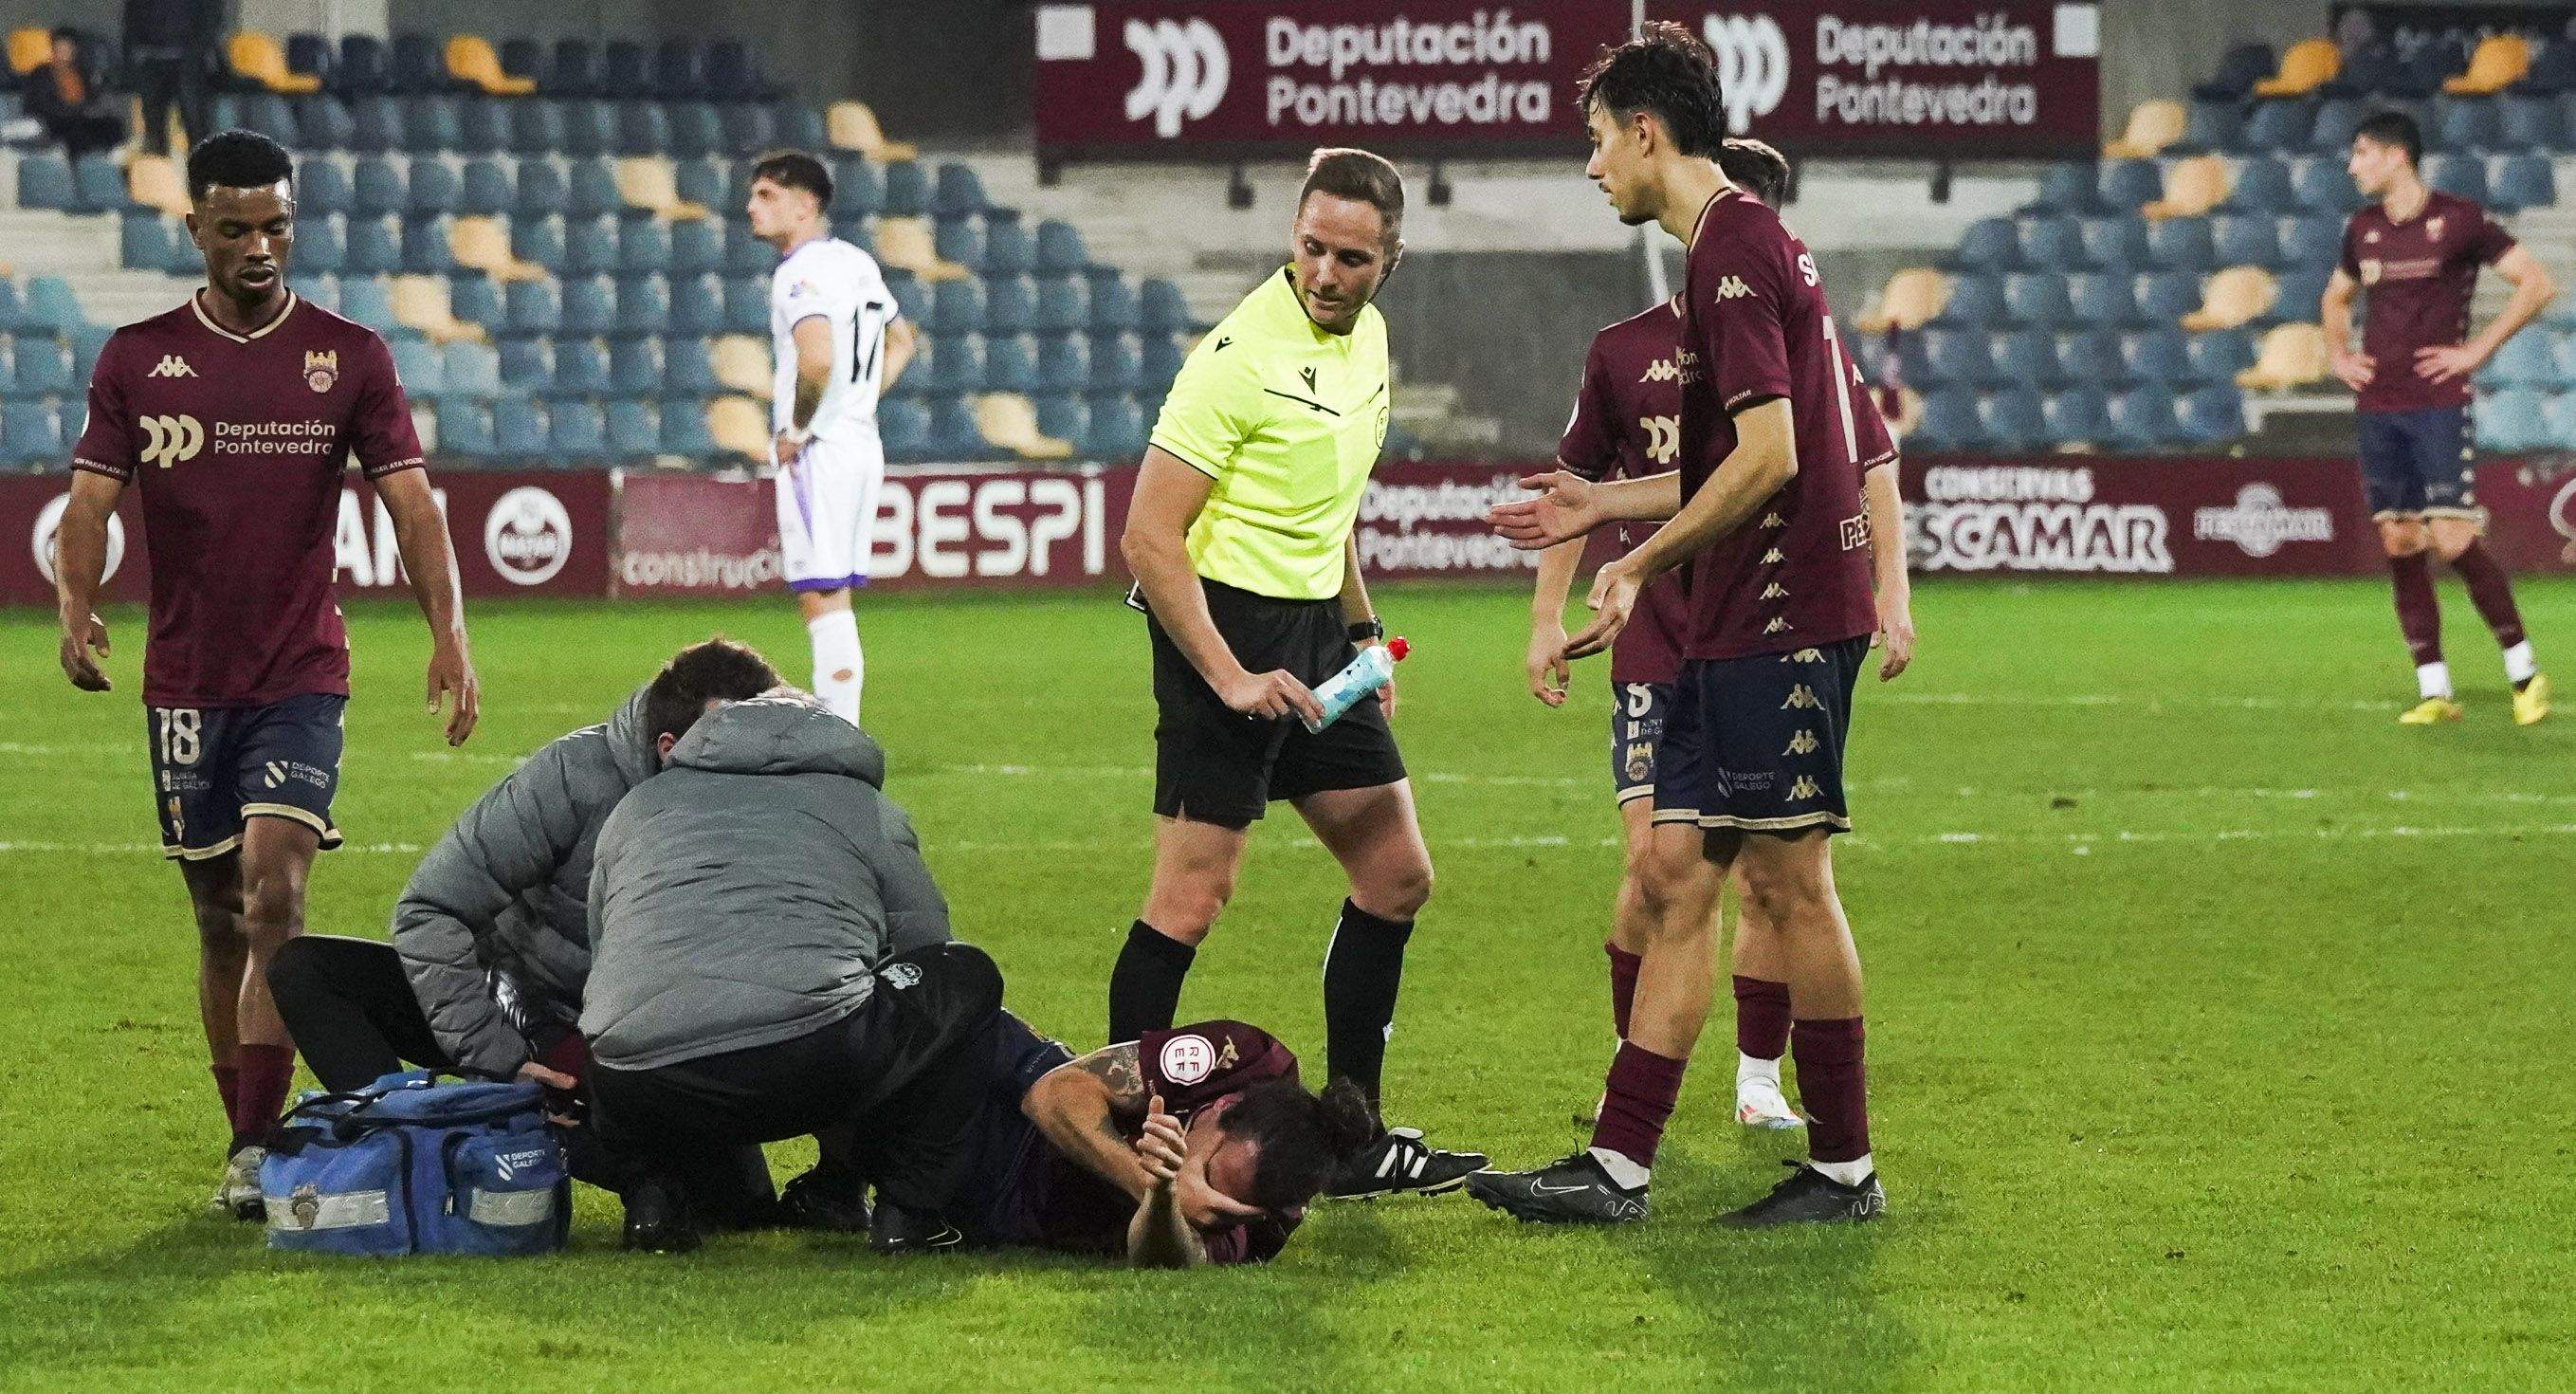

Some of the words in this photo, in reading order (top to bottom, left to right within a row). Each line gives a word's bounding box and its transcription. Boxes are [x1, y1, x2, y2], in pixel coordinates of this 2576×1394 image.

[1265, 9, 1551, 80] Deputación
[1816, 11, 2037, 80] Deputación
[1266, 72, 1551, 125] Pontevedra
[1816, 75, 2037, 124] Pontevedra
[850, 301, 883, 384] 17
[214, 439, 333, 454] Pontevedra
[215, 420, 336, 440] Deputación
[156, 707, 202, 764] 18
[1732, 771, 1777, 781] DEPORTE
